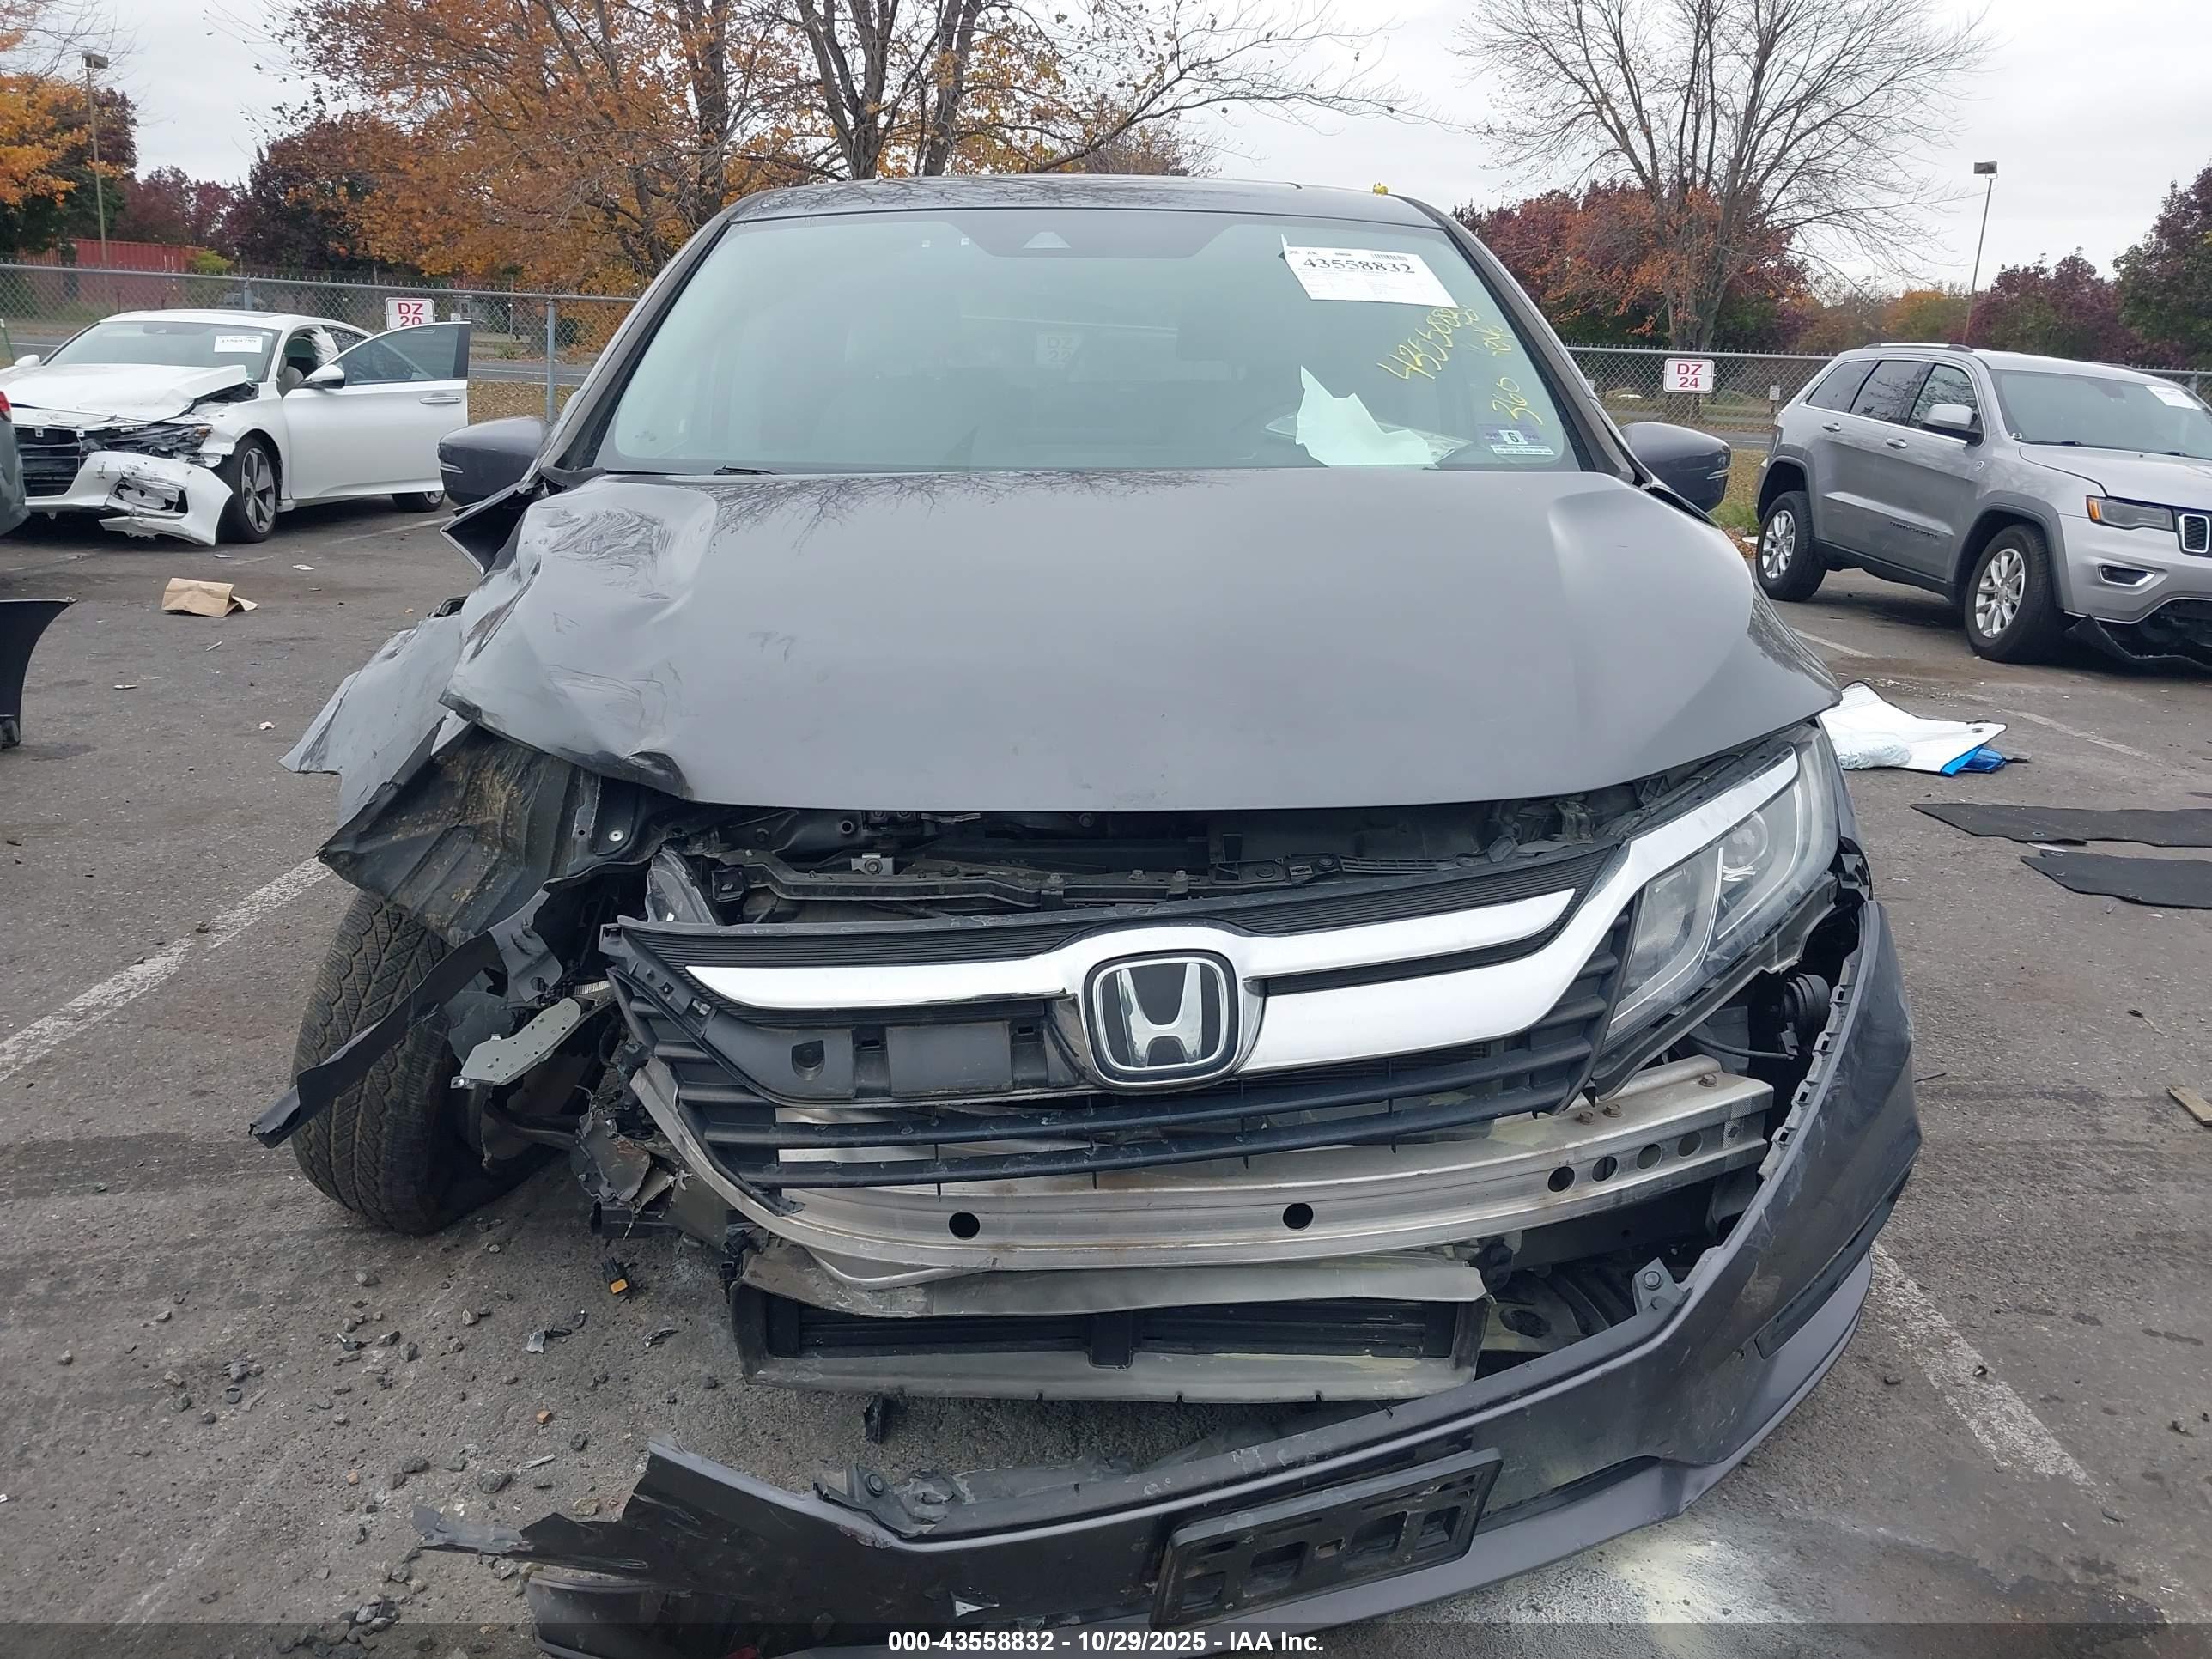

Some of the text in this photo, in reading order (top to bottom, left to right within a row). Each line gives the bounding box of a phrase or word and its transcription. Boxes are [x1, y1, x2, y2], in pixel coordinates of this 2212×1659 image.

[1304, 258, 1415, 274] 43558832
[398, 302, 424, 315] DZ
[399, 316, 422, 326] 20
[1676, 363, 1704, 375] DZ
[1678, 376, 1700, 389] 24
[1491, 376, 1544, 426] 360
[1508, 431, 1519, 443] 6
